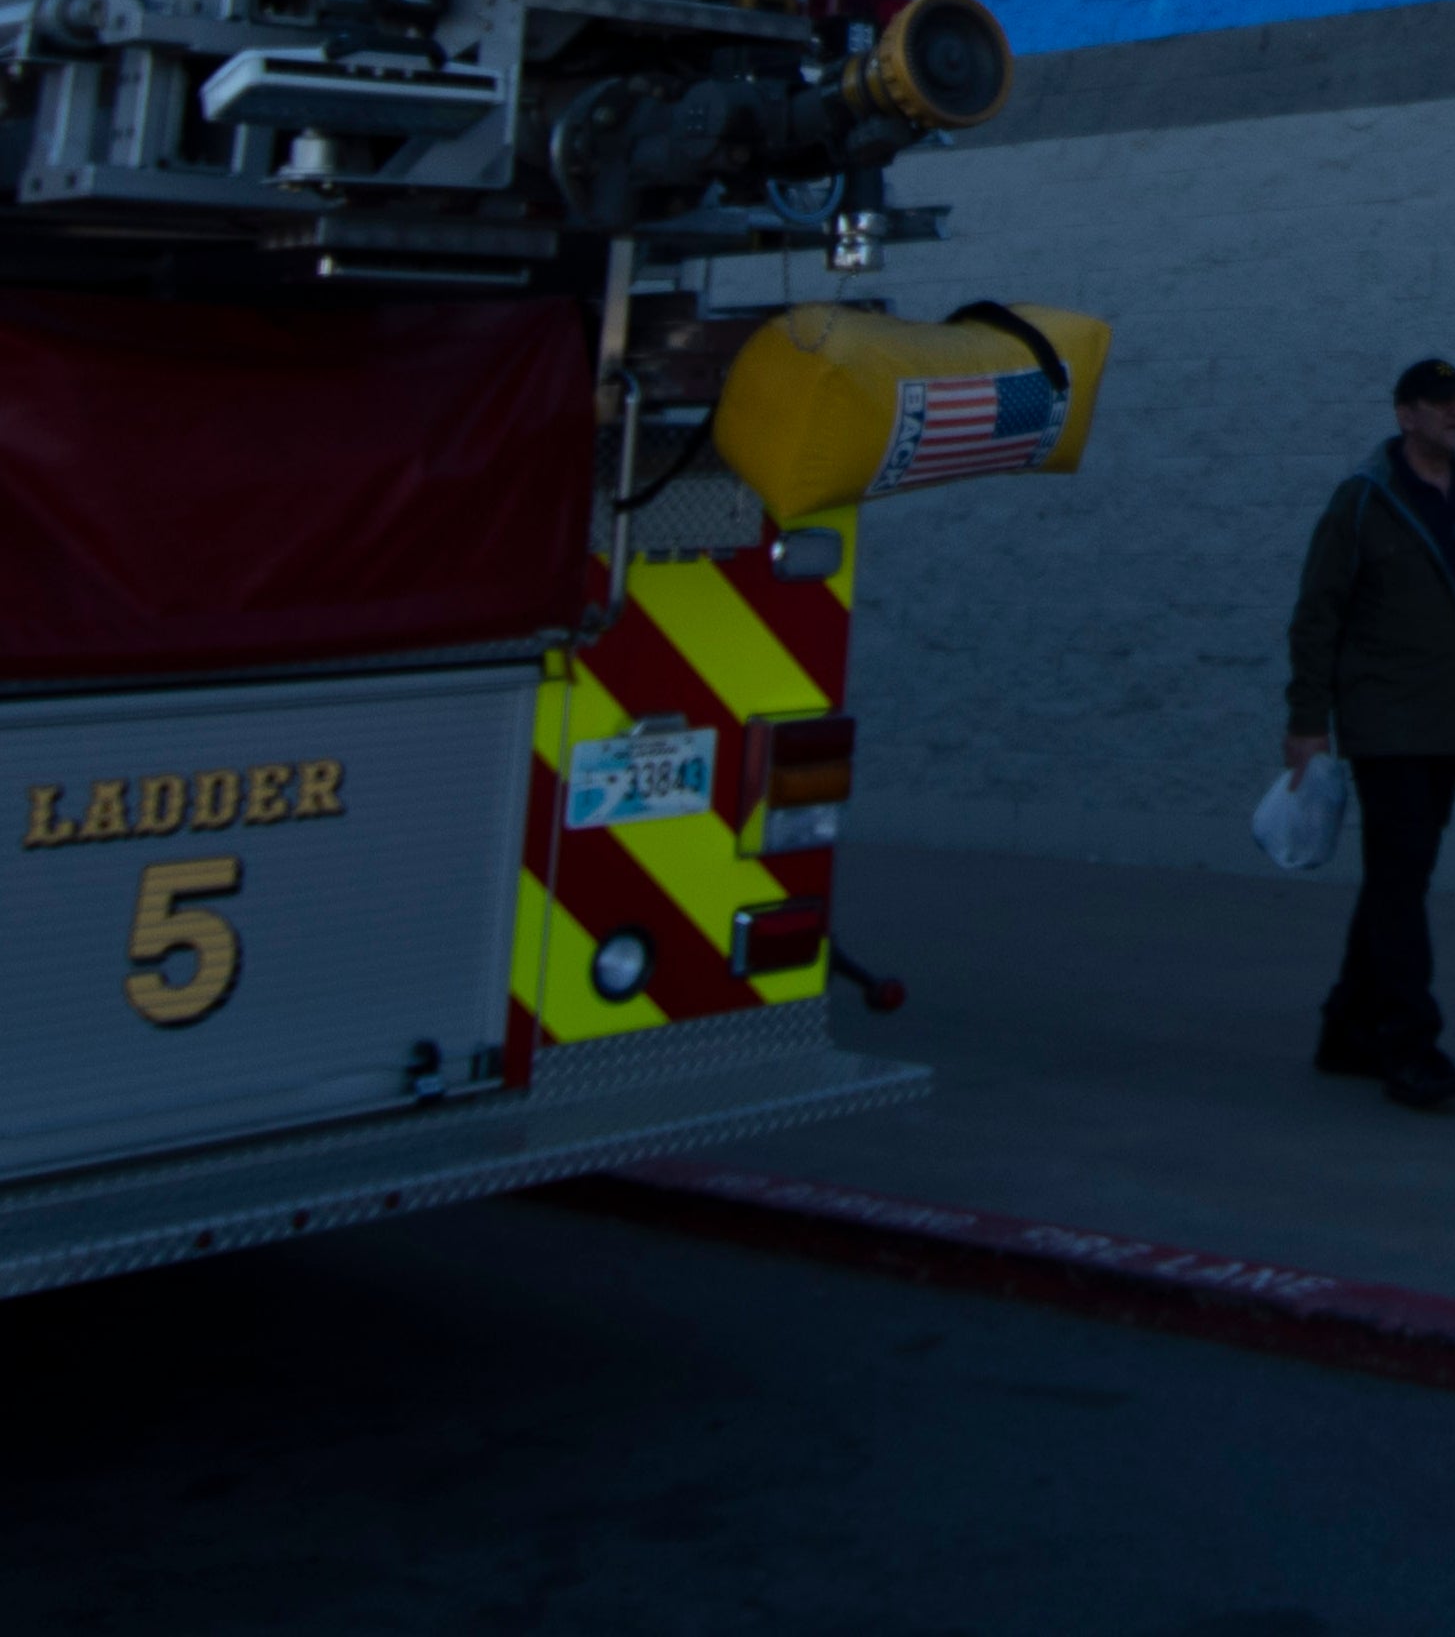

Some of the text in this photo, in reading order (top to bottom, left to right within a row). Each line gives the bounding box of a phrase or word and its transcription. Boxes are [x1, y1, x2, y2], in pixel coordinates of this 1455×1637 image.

[871, 384, 926, 491] BACK
[23, 759, 346, 848] LADDER
[122, 854, 244, 1029] 5
